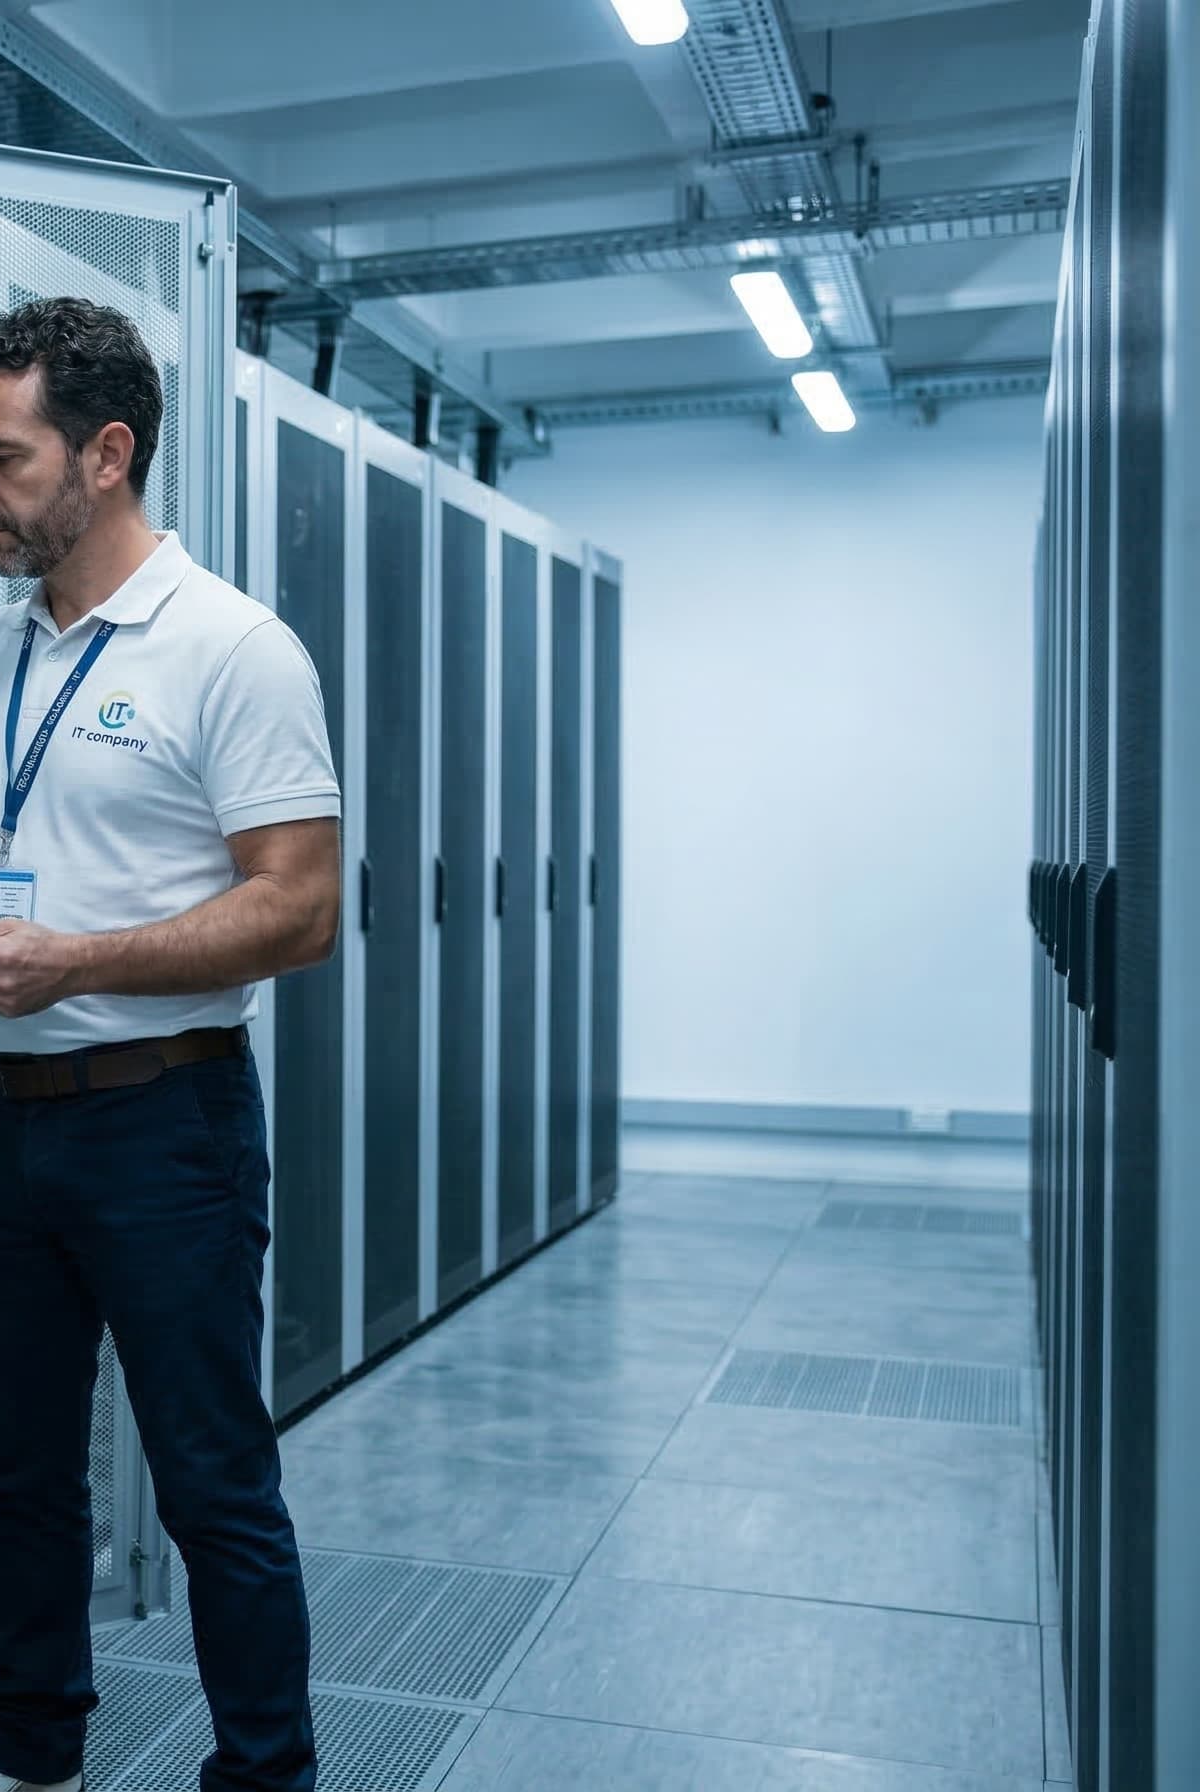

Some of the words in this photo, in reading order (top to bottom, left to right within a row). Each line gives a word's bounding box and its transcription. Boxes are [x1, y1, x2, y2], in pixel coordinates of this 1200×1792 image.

[106, 702, 129, 720] IT
[72, 726, 86, 739] IT
[87, 732, 149, 752] company
